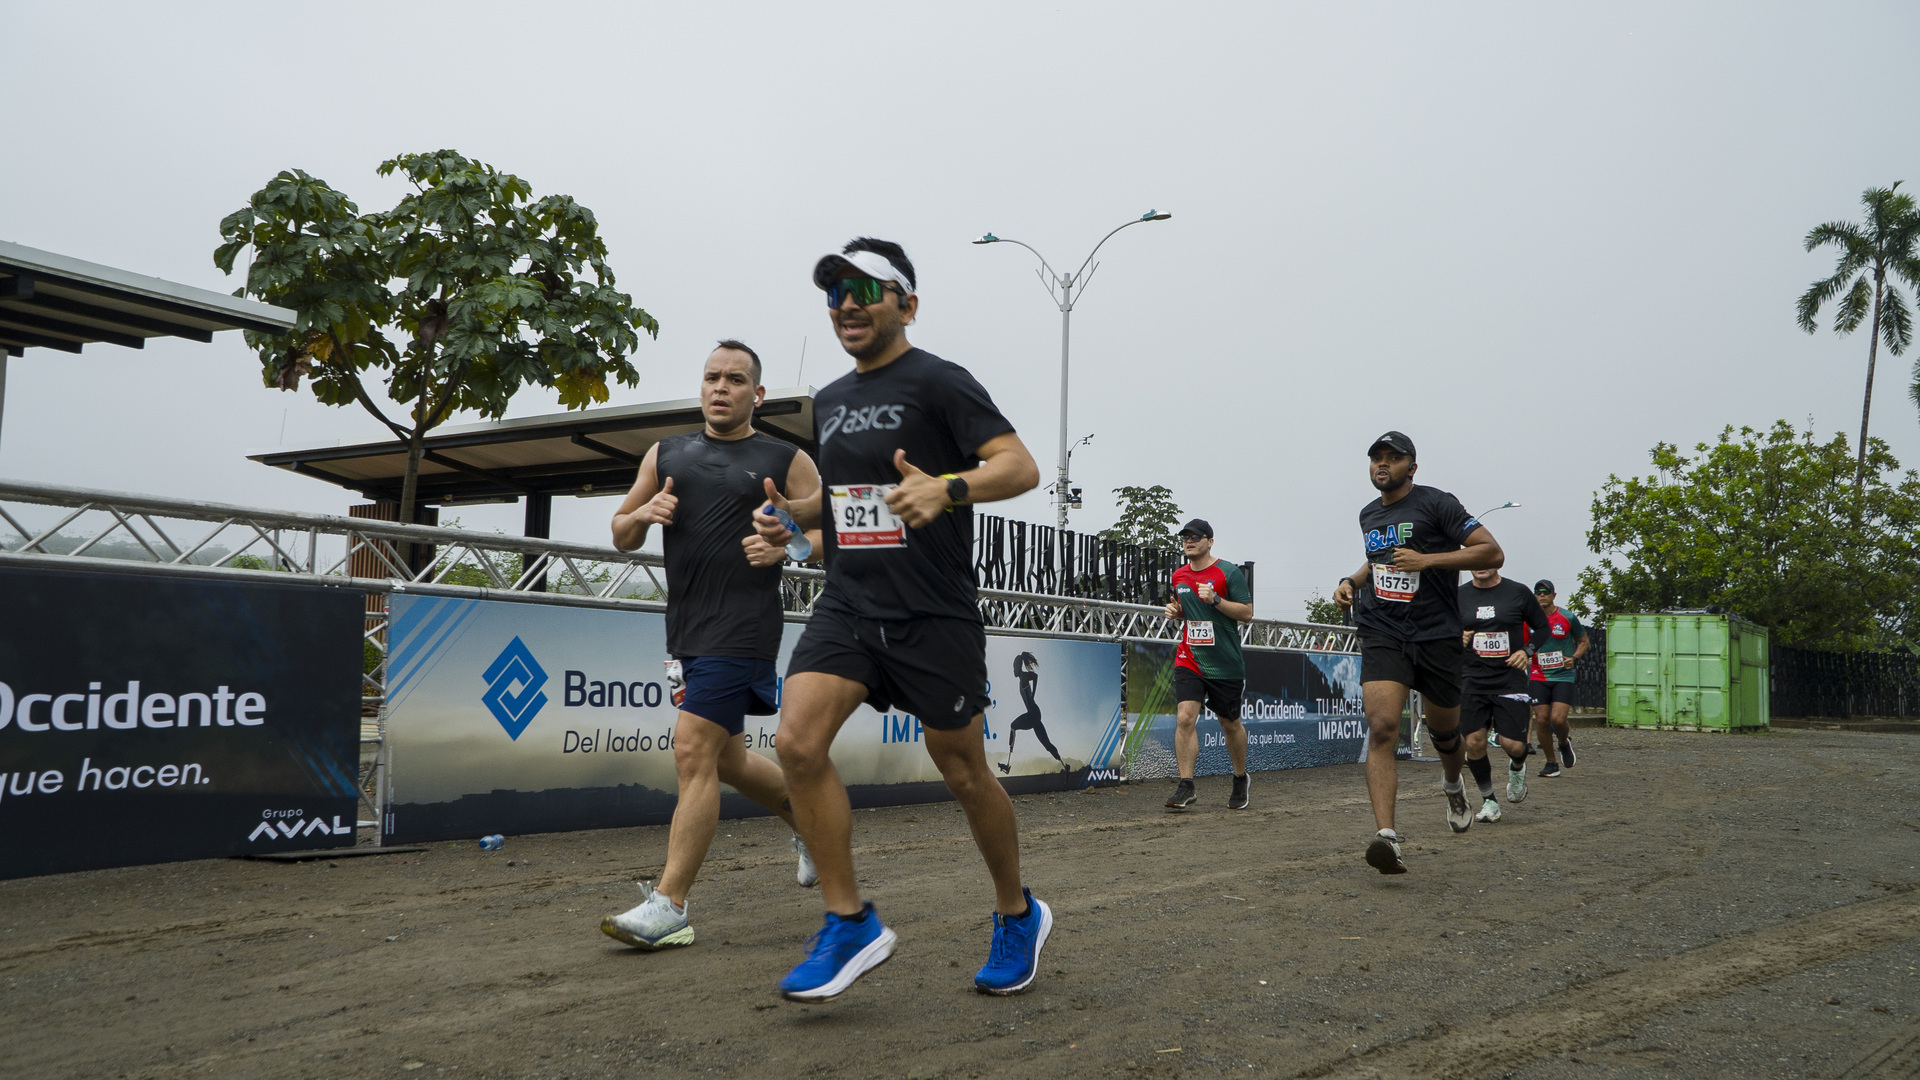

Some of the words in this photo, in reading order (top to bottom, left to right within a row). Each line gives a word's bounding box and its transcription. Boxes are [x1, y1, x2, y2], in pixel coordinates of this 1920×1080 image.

[845, 505, 879, 527] 921
[1380, 575, 1410, 590] 1575
[1191, 629, 1208, 638] 173
[1483, 640, 1500, 649] 180
[1542, 656, 1559, 665] 1693
[564, 670, 663, 708] Banco
[1241, 698, 1254, 720] de
[1255, 699, 1305, 720] Occidente
[1316, 698, 1329, 716] TU
[1331, 698, 1366, 718] HACER,
[1204, 731, 1218, 747] Del
[1247, 730, 1258, 745] los
[1259, 733, 1273, 748] que
[1273, 730, 1296, 743] hacen.
[1318, 720, 1366, 741] IMPACTA.
[562, 728, 600, 754] Del
[606, 728, 652, 753] lado
[77, 757, 210, 792] hacen.
[1087, 769, 1119, 781] AVAL
[262, 808, 304, 819] Grupo
[248, 815, 351, 842] AVAL
